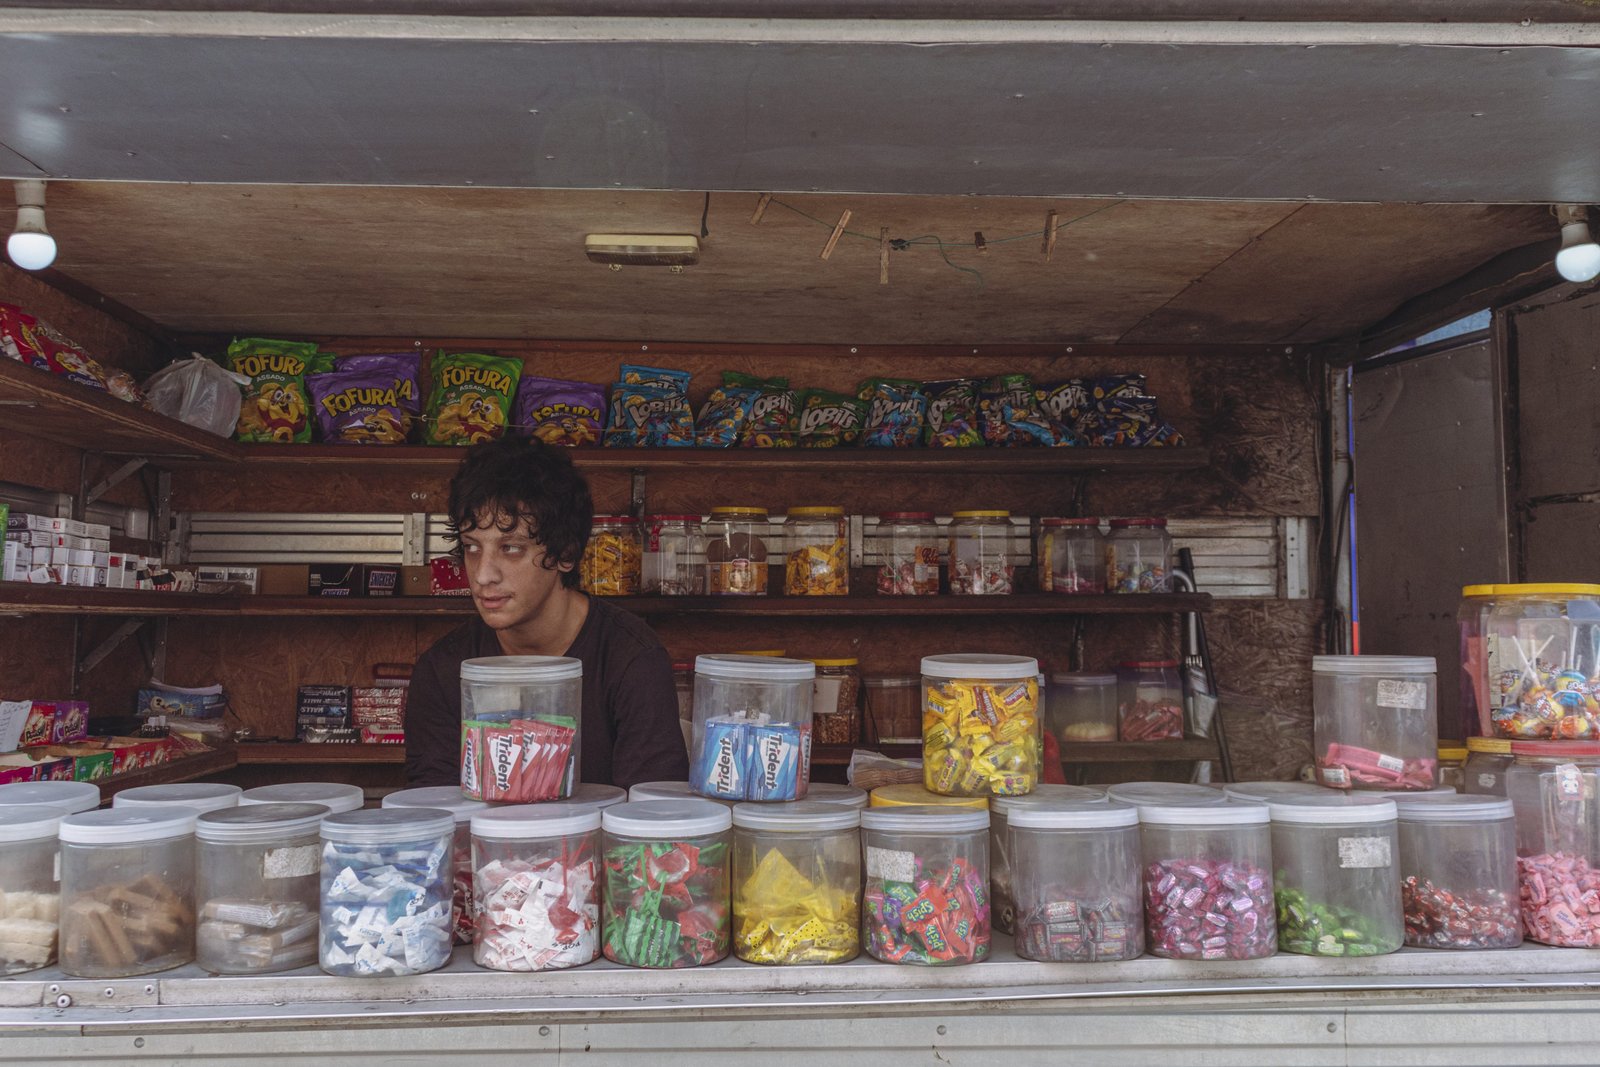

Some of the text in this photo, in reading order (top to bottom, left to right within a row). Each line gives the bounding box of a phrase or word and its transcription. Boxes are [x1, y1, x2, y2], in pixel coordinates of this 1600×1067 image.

[232, 355, 305, 377] FOFURA
[441, 365, 512, 396] FOFURA
[321, 387, 398, 417] FOFURA
[459, 384, 487, 394] ASSADO
[497, 735, 514, 791] Trident
[716, 737, 732, 793] Trident
[766, 733, 783, 790] Trident
[905, 899, 934, 922] Spish
